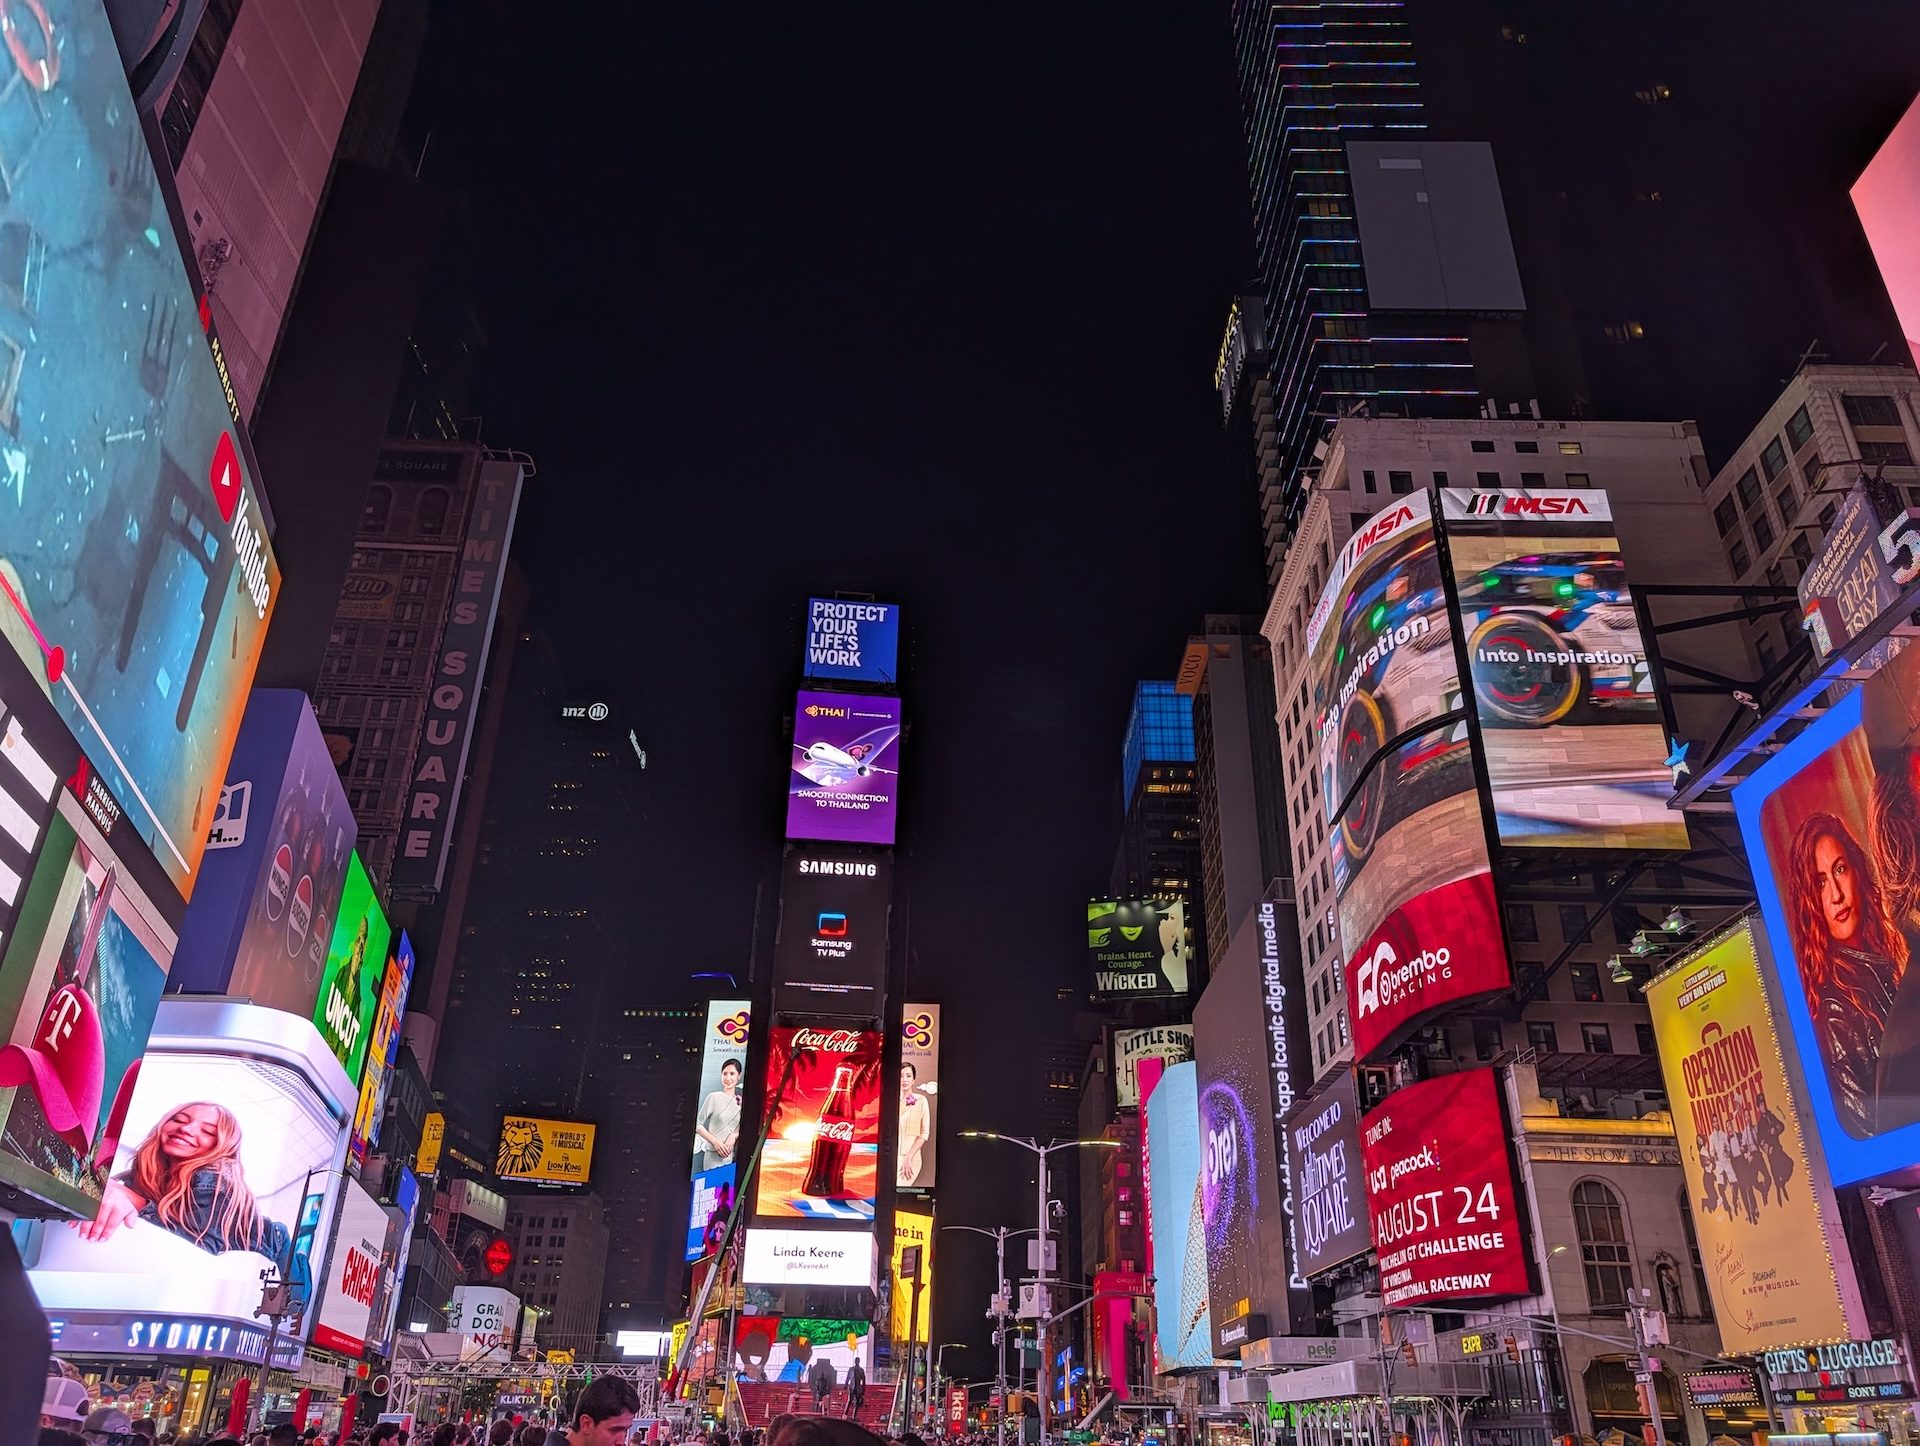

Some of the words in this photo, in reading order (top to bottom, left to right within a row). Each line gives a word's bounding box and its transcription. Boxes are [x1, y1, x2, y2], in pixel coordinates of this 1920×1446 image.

[212, 337, 240, 422] MARRIOTT
[1503, 497, 1591, 515] IMSA
[1356, 505, 1415, 560] IMSA
[231, 487, 270, 619] YouTube
[452, 480, 505, 625] TIMES
[813, 602, 888, 622] PROTECT
[812, 617, 858, 635] YOUR
[809, 648, 862, 667] WORK
[1478, 648, 1520, 664] Into
[1526, 648, 1637, 666] Inspiration
[1322, 704, 1339, 741] Into
[1340, 615, 1430, 709] Inspiration
[819, 707, 845, 717] THAI
[404, 650, 469, 858] SQUARE
[91, 776, 120, 821] MARRIOTT
[797, 790, 834, 799] SMOOTH
[835, 792, 889, 803] CONNECTION
[816, 799, 828, 808] TO
[828, 800, 870, 810] THAILAND
[86, 791, 113, 834] MARQUIS
[800, 860, 877, 877] SAMSUNG
[1258, 903, 1279, 956] media
[811, 939, 852, 950] Samsung
[817, 948, 828, 957] TV
[828, 949, 846, 957] Plus
[1097, 952, 1127, 961] Brains.
[1127, 951, 1154, 960] Heart.
[1107, 961, 1145, 969] Courage.
[1391, 947, 1450, 990] brembo
[1262, 958, 1287, 1013] digital
[1393, 966, 1452, 1005] RACING
[325, 981, 361, 1056] UNCUT
[1124, 1029, 1164, 1056] LITTLE
[1268, 1015, 1289, 1069] iconic
[1682, 1024, 1760, 1099] OPERATION
[1294, 1112, 1330, 1152] WELCOME
[1329, 1101, 1342, 1126] TO
[1365, 1122, 1383, 1147] TUNE
[557, 1139, 585, 1150] MUSICAL
[1584, 1148, 1626, 1161] SHOW
[547, 1159, 562, 1171] LION
[563, 1161, 582, 1173] KING
[1390, 1145, 1435, 1189] peacock
[1376, 1190, 1444, 1248] AUGUST
[1453, 1182, 1501, 1224] 24
[773, 1246, 806, 1257] Linda
[809, 1247, 845, 1258] Keene
[1379, 1249, 1407, 1272] MICHELIN
[1406, 1247, 1417, 1261] GT
[1418, 1232, 1505, 1259] CHALLENGE
[1384, 1281, 1429, 1306] INTERNATIONAL
[1430, 1273, 1492, 1294] RACEWAY
[1388, 1268, 1412, 1288] VIRGINIA
[1748, 1285, 1764, 1294] NEW
[1765, 1279, 1800, 1291] MUSICAL
[128, 1322, 231, 1351] SYDNEY
[1764, 1347, 1809, 1375] GIFTS
[1818, 1338, 1900, 1371] LUGGAGE
[1688, 1375, 1751, 1391] ELECTRONICS
[1796, 1390, 1816, 1401] Nikon
[1818, 1388, 1845, 1400] Canon
[1848, 1386, 1876, 1398] SONY
[500, 1394, 537, 1405] KLIKTIX
[951, 1390, 965, 1421] tkts
[1693, 1393, 1721, 1403] CAMERA
[1722, 1391, 1755, 1402] LUGGAGE
